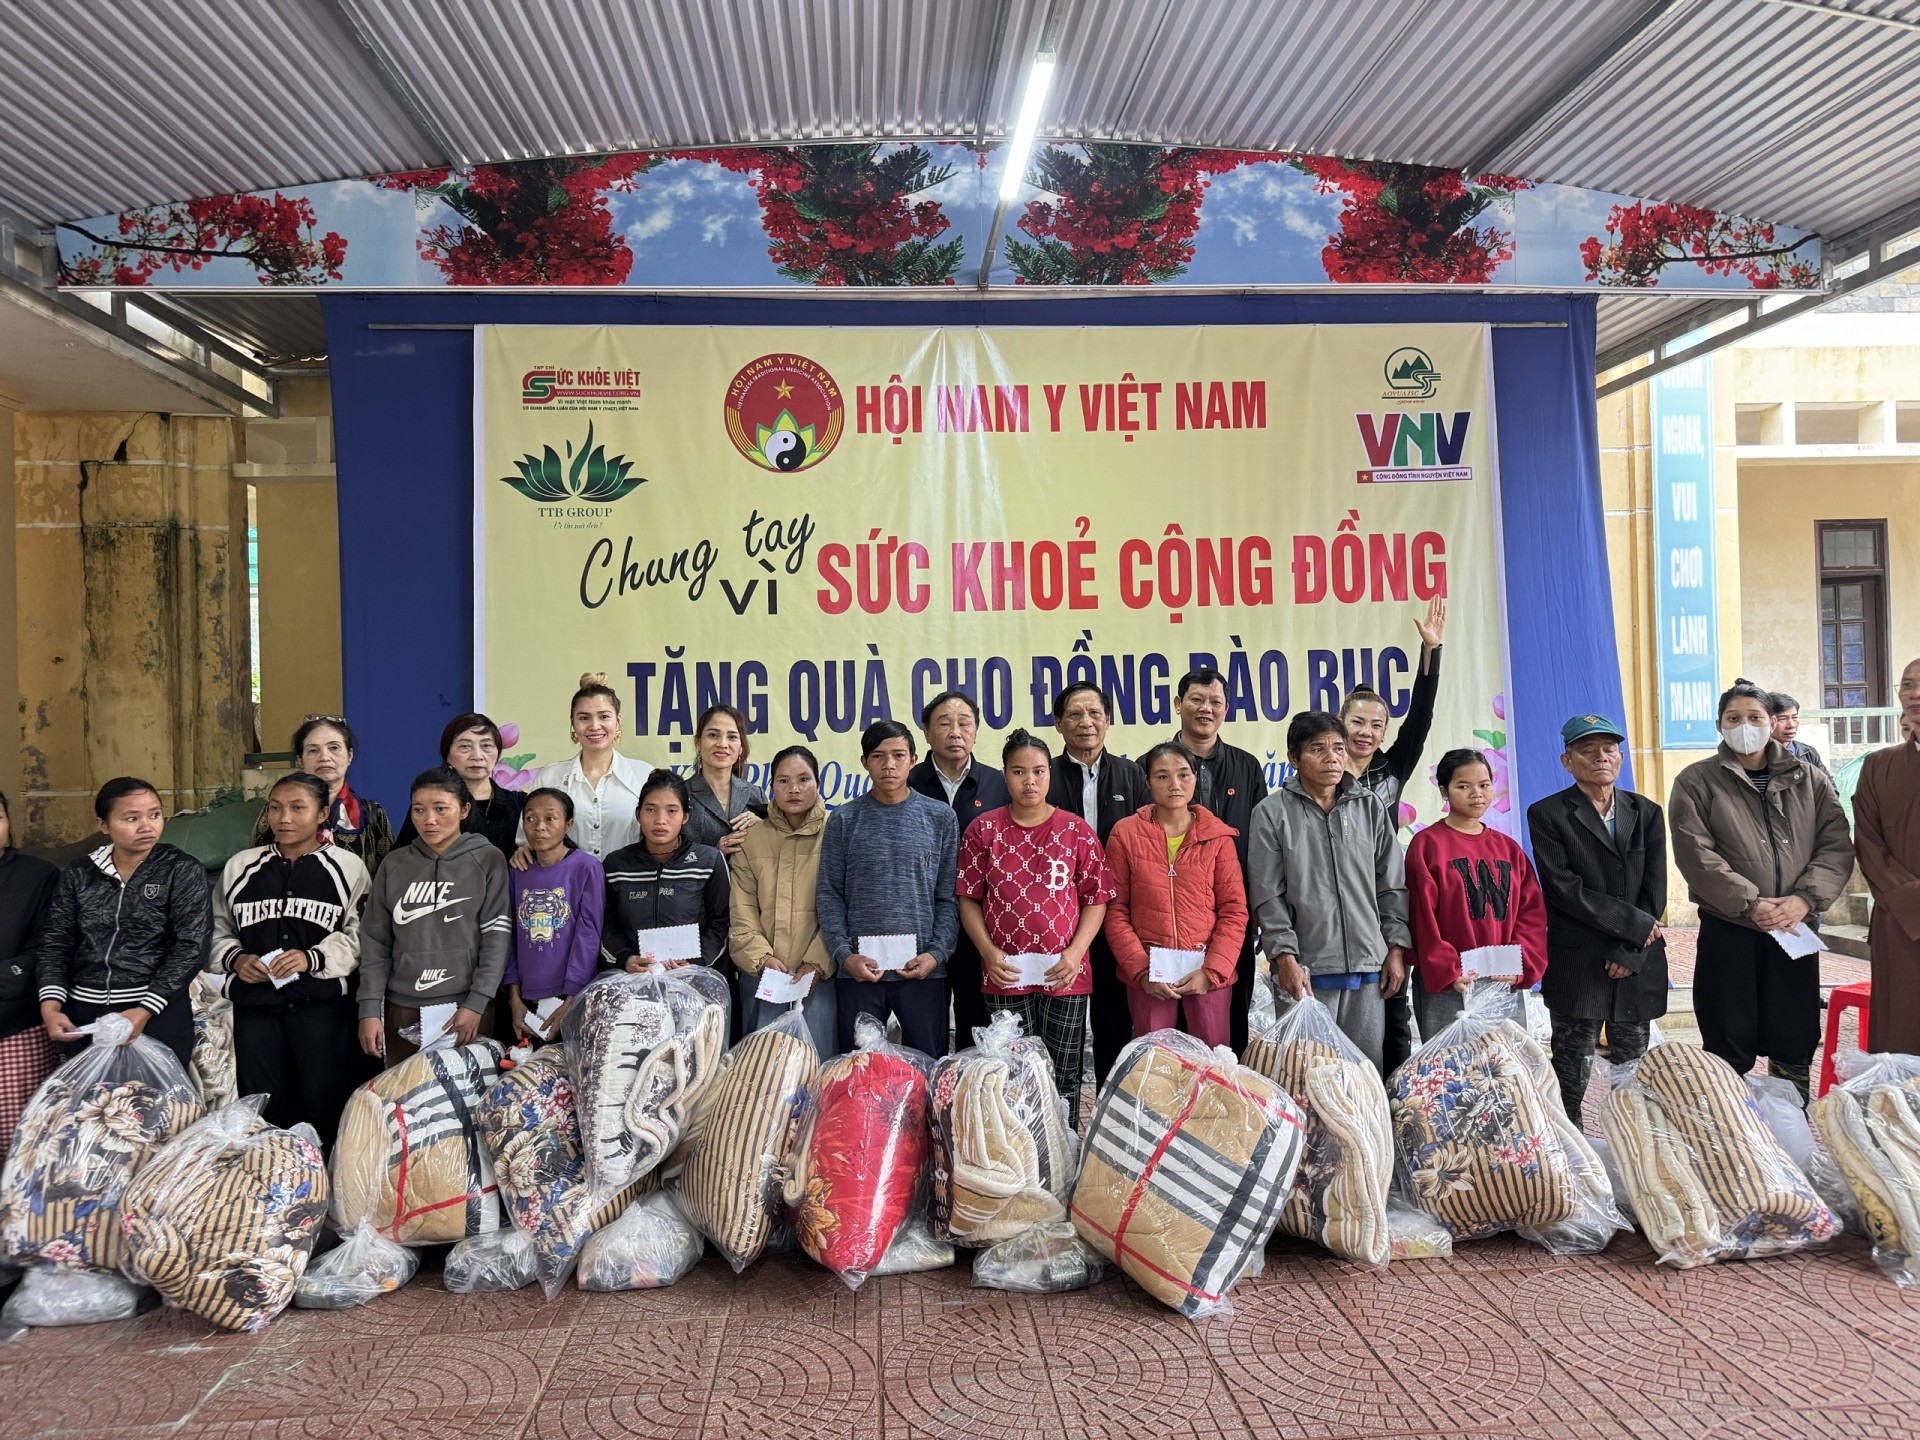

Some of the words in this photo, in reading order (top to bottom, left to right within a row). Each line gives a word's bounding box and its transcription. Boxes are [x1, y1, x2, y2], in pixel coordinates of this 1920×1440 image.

[614, 368, 640, 389] VIỆT
[731, 375, 747, 396] HỘI
[746, 358, 773, 376] NAM
[790, 357, 816, 373] VIỆT
[817, 372, 837, 397] NAM
[786, 366, 811, 379] MEDICINE
[856, 374, 923, 445] HỘI
[937, 384, 1029, 433] NAM
[1043, 384, 1067, 433] Y
[1079, 372, 1162, 443] VIỆT
[1175, 380, 1267, 431] NAM
[1355, 411, 1471, 467] VNV
[538, 507, 564, 517] TTB
[567, 507, 613, 517] GROUP
[1671, 482, 1698, 522] VUI
[579, 536, 719, 610] Chung
[742, 509, 816, 575] tay
[816, 527, 931, 615] SỨC
[952, 516, 1099, 613] KHOẺ
[1119, 523, 1274, 624] CỘNG
[1291, 509, 1448, 605] ĐỒNG
[1671, 545, 1703, 588] CHƠI
[1671, 607, 1708, 655] LÀNH
[627, 645, 769, 753] TẶNG
[788, 643, 893, 742] QUÀ
[1189, 635, 1290, 723] ÀO
[1670, 681, 1712, 731] MẠNH
[403, 881, 455, 903] NIKE
[1045, 858, 1070, 891] B
[1451, 857, 1512, 921] W
[524, 916, 562, 928] KENZO
[420, 968, 447, 981] NIKE
